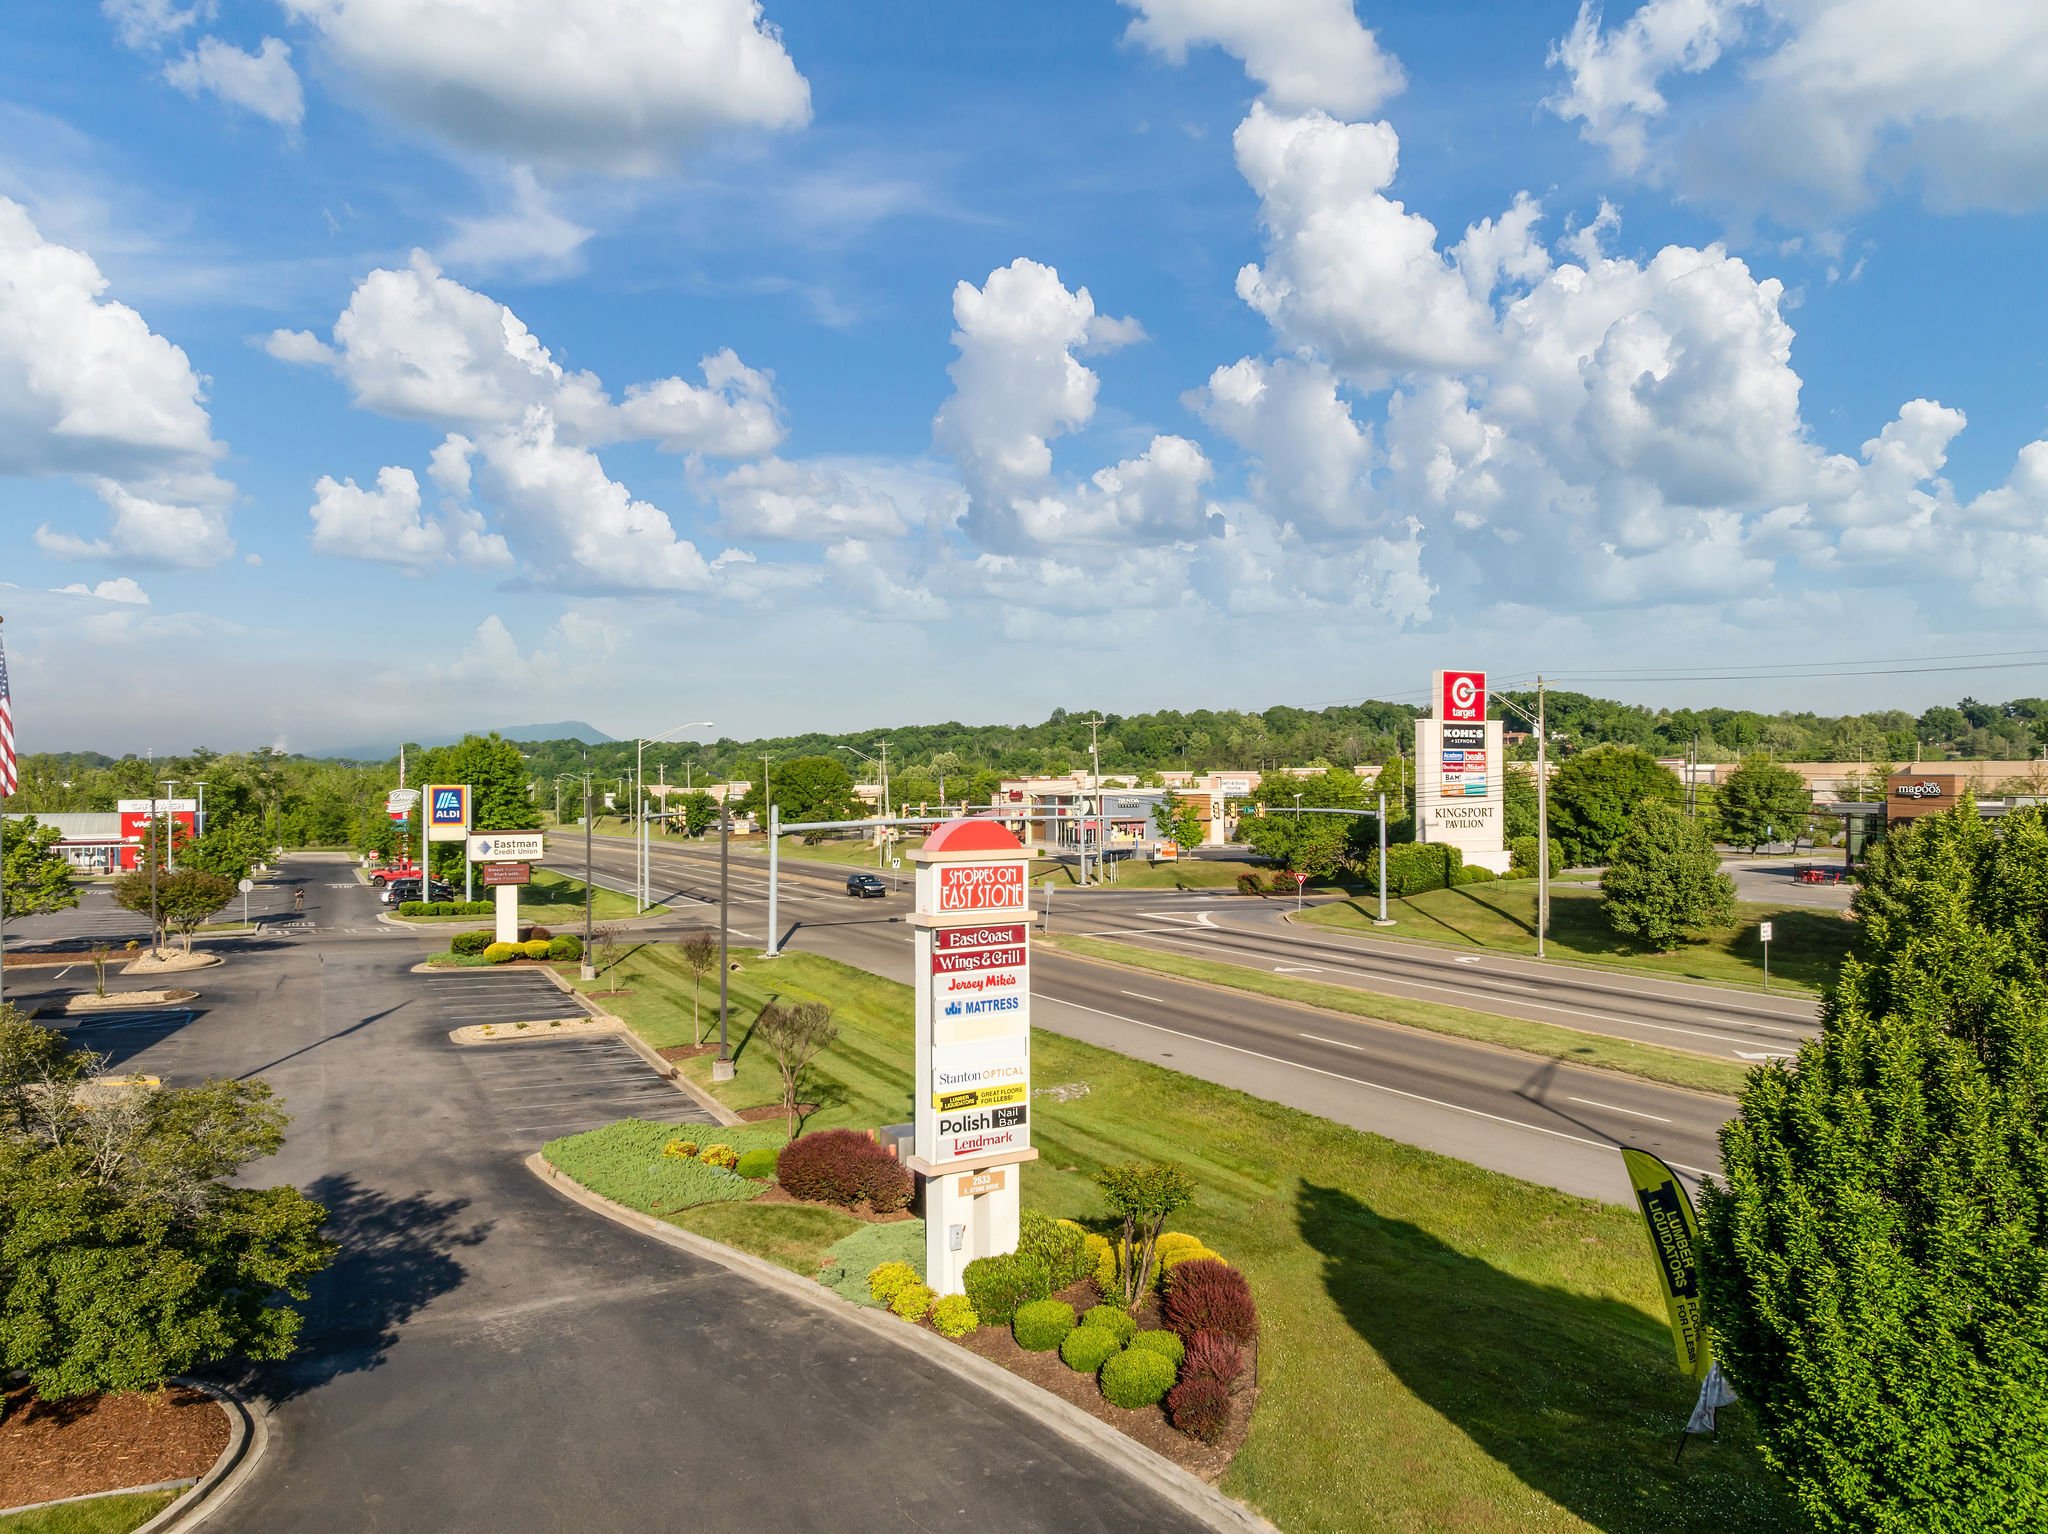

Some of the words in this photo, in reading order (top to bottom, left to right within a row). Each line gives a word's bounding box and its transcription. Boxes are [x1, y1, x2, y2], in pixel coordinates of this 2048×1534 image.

[1452, 708, 1476, 719] target
[1443, 729, 1484, 739] KOHL'S
[435, 810, 460, 818] ALDI
[1435, 807, 1494, 818] KINGSPORT
[1445, 819, 1484, 828] PAVILION
[494, 840, 538, 848] Eastman
[949, 867, 995, 885] SHOPPES
[997, 868, 1017, 883] ON
[941, 884, 974, 908] EAST
[977, 883, 1023, 907] STONE
[939, 955, 980, 970] Wings
[981, 952, 991, 965] &
[992, 950, 1020, 965] Grill
[948, 978, 983, 992] Jersey
[985, 974, 1016, 987] Mike's
[965, 997, 1019, 1014] MATTRESS
[939, 1072, 981, 1085] Stanton
[983, 1066, 1024, 1080] OPTICAL
[981, 1090, 1000, 1098] GREAT
[1000, 1087, 1023, 1095] FLOORS
[998, 1107, 1019, 1118] Nail
[940, 1113, 990, 1136] Polish
[999, 1117, 1018, 1127] Bar
[954, 1131, 1013, 1150] Lendmark
[973, 1174, 991, 1185] 2633
[1648, 1199, 1687, 1289] LIQUIDATORS
[1667, 1210, 1695, 1268] LUMBER
[1676, 1305, 1689, 1326] FOR
